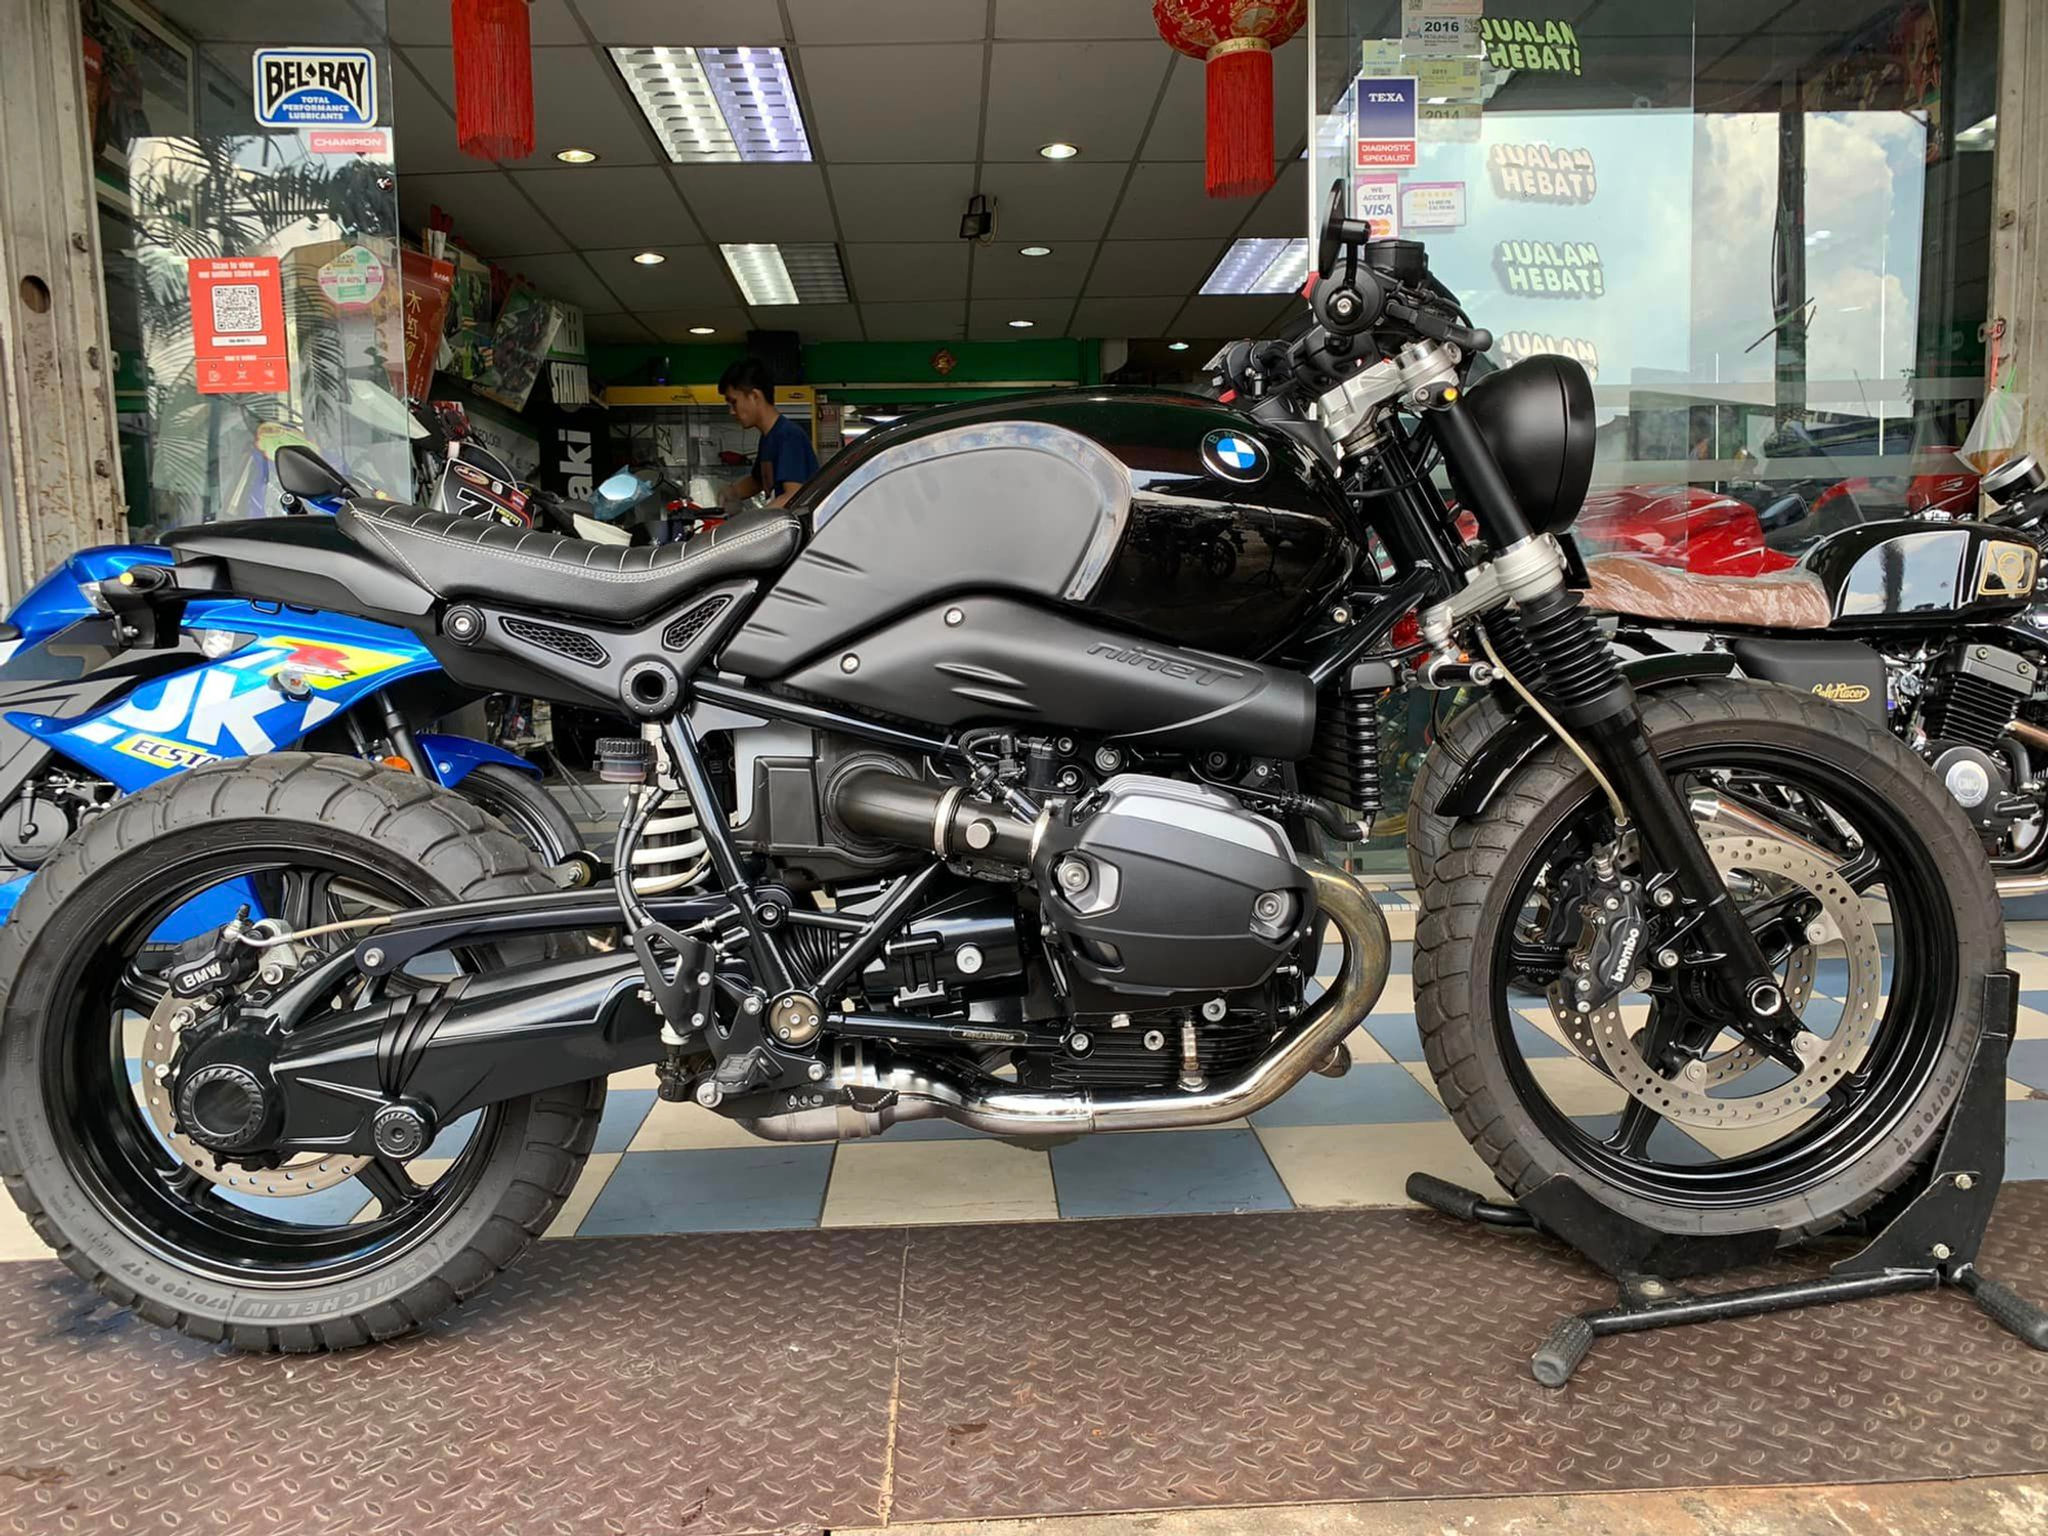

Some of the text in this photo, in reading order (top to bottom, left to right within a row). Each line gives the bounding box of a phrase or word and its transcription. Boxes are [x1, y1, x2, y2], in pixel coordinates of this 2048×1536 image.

[1424, 21, 1459, 32] 2016
[1480, 18, 1578, 47] JUALAN
[1489, 43, 1582, 76] HEBAT!
[282, 104, 350, 112] PERFORMANCE
[1368, 92, 1405, 102] TEXA
[313, 137, 381, 147] CHAMPION
[1361, 144, 1412, 152] DIAGNOSTIC
[1362, 154, 1411, 162] SPECIALIST
[1494, 145, 1593, 172] JUALAN
[1501, 167, 1595, 199] HEBAT!
[1362, 203, 1394, 216] VISA
[1501, 242, 1599, 266] JUALAN
[1508, 267, 1603, 294] HEBAT!
[1501, 332, 1598, 364] JUALAN
[1610, 928, 1640, 982] brembo
[182, 962, 222, 988] BMW
[1924, 1068, 1959, 1123] 120/70
[120, 1261, 145, 1276] 17
[244, 1275, 398, 1318] MICHELIN
